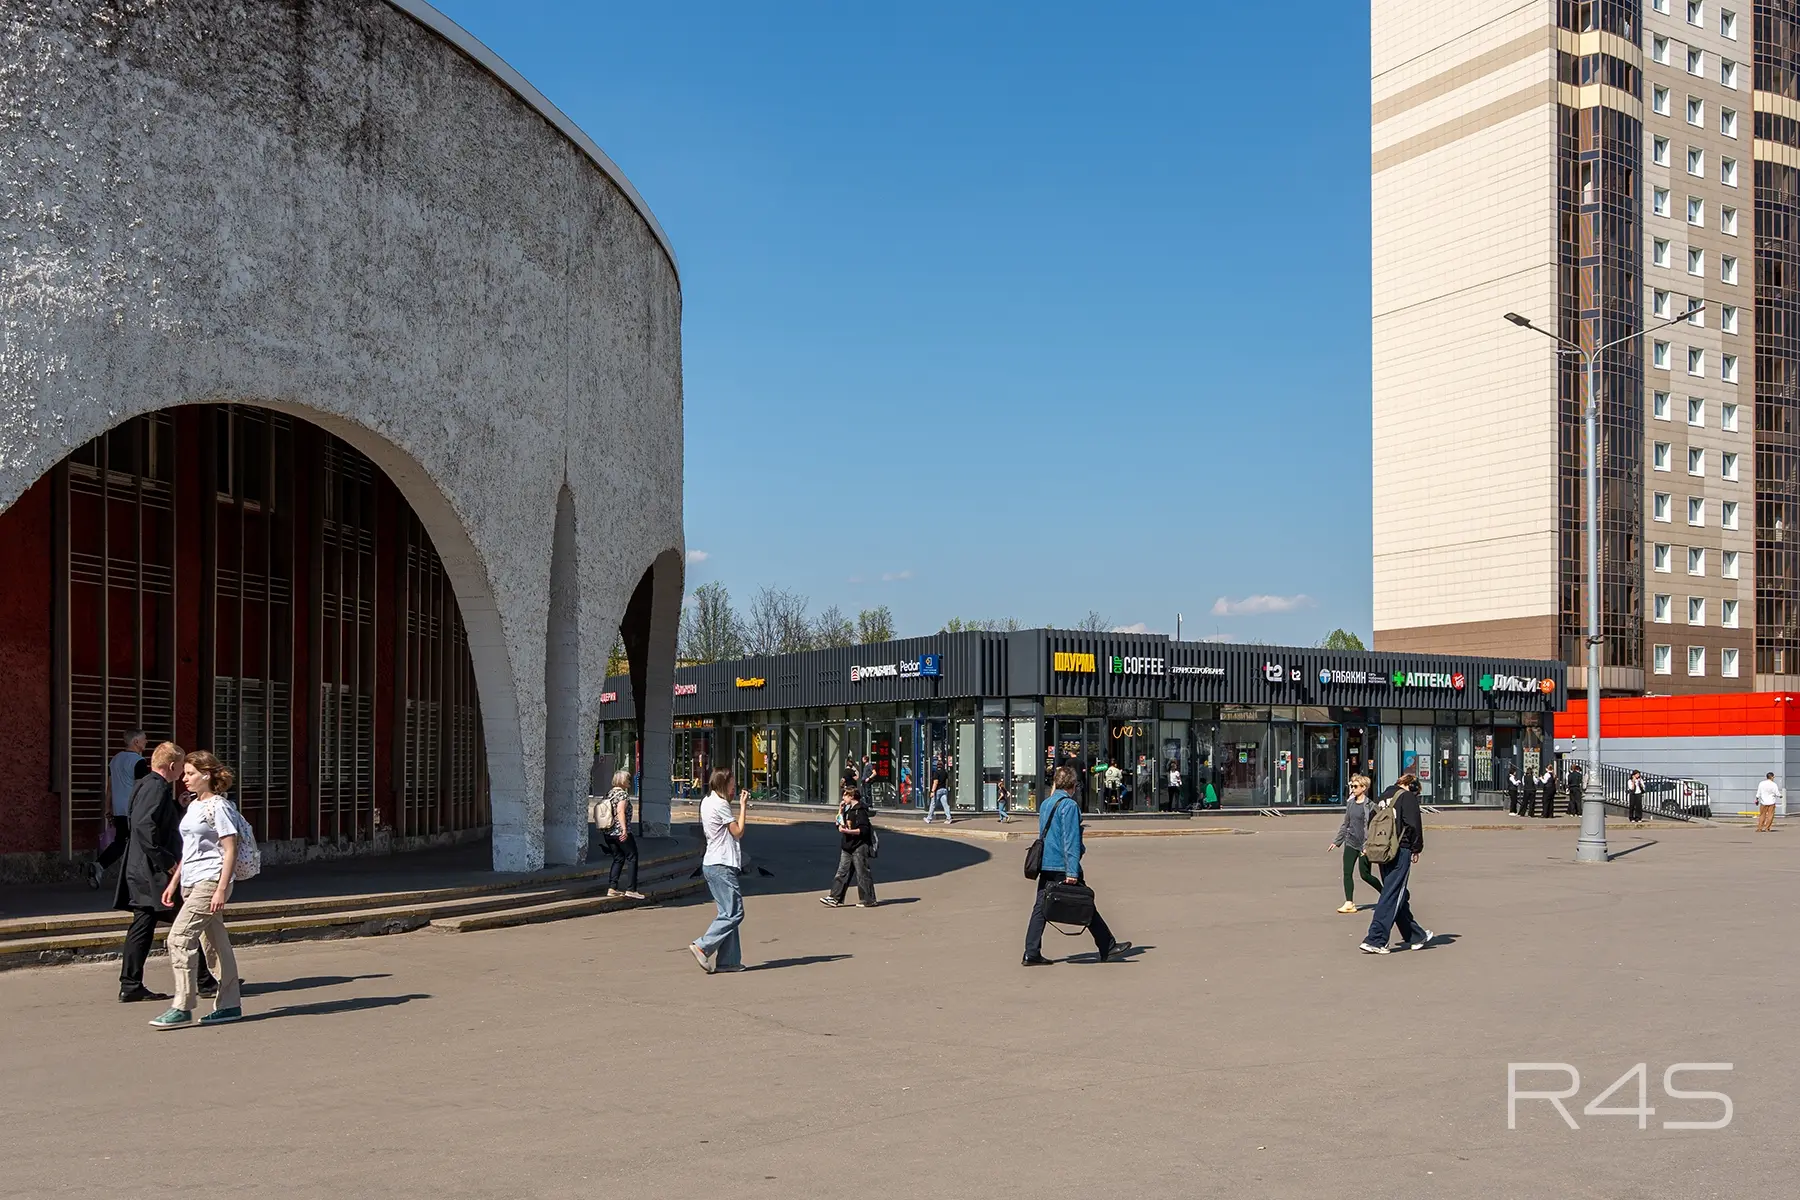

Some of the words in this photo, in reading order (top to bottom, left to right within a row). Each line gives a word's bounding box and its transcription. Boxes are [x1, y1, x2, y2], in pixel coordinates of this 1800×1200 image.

[860, 664, 898, 678] ФОРАБАНК
[1054, 652, 1096, 673] ШАУРМА
[1113, 656, 1123, 674] CUP
[1124, 657, 1165, 675] COFFEE
[1332, 670, 1366, 684] ТАБАКИН
[1405, 672, 1452, 688] АПТЕКА
[1493, 674, 1537, 692] ДИКСИ
